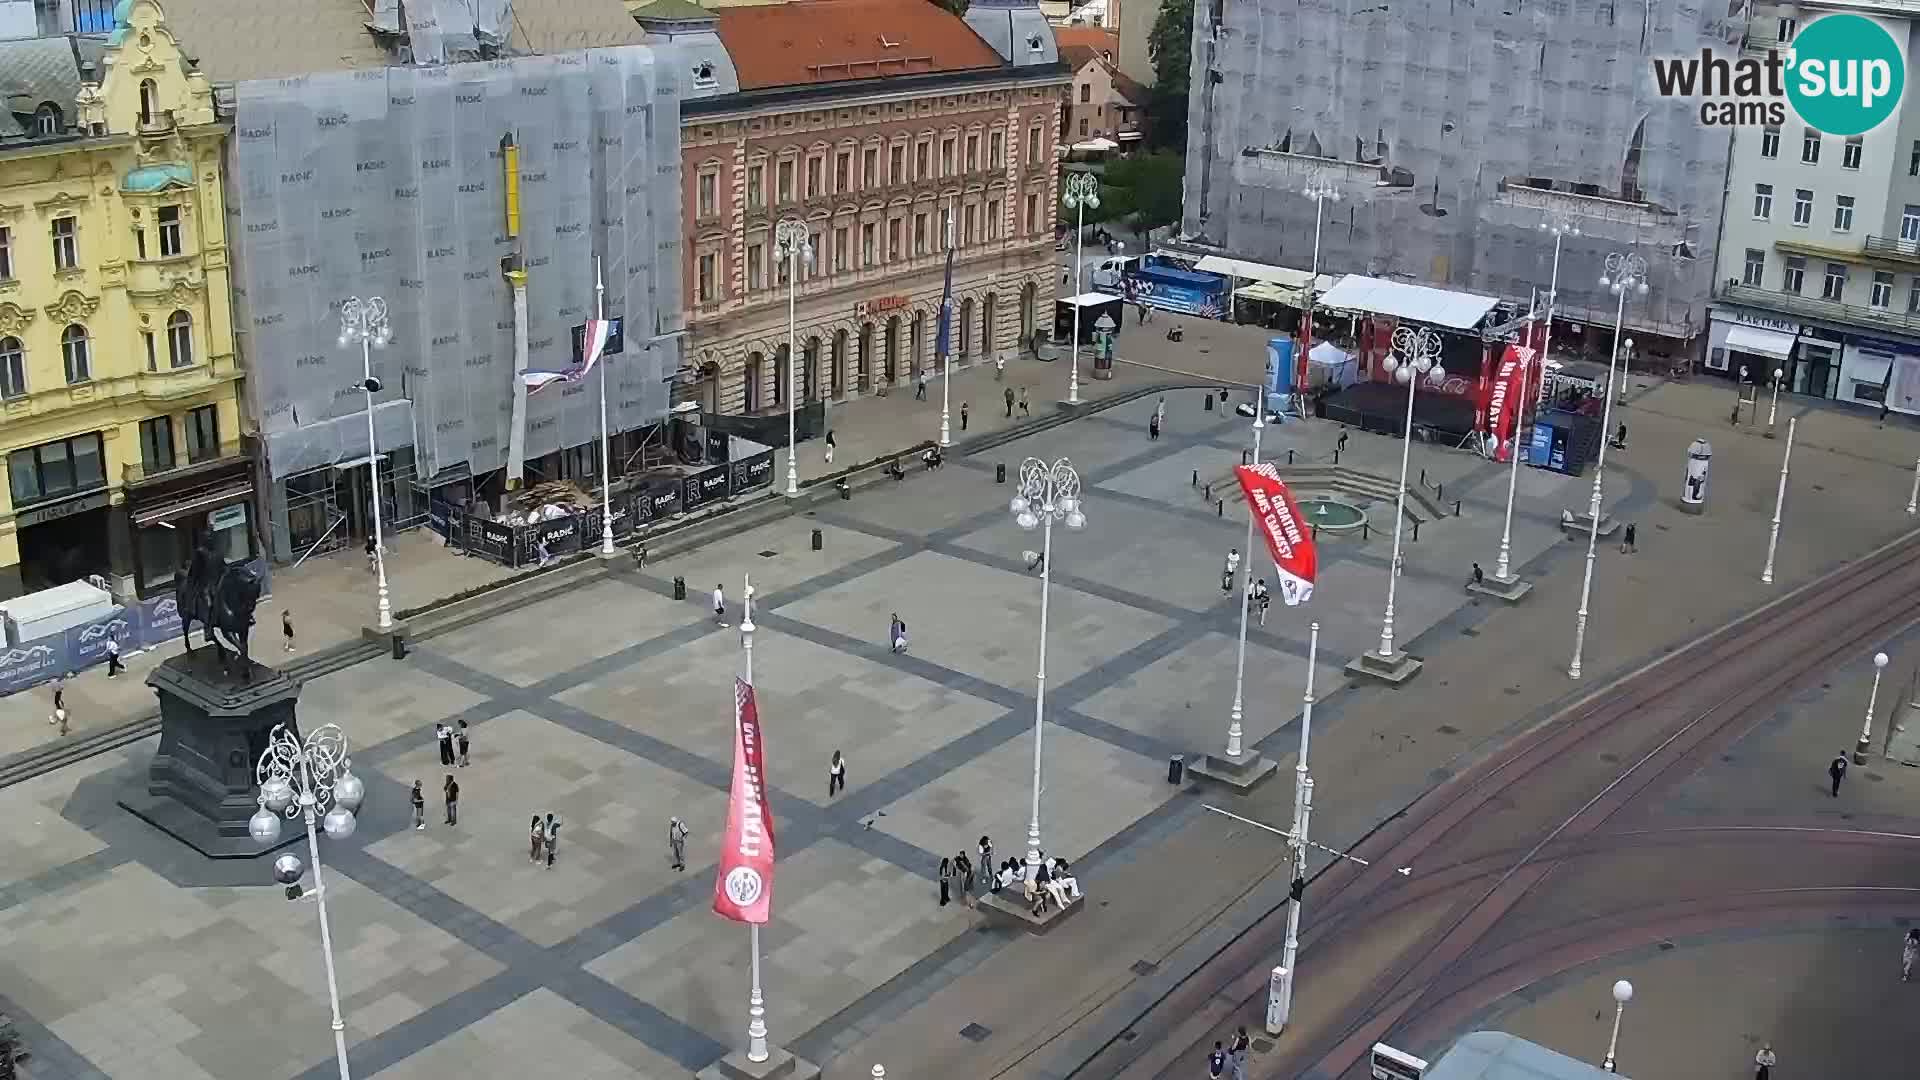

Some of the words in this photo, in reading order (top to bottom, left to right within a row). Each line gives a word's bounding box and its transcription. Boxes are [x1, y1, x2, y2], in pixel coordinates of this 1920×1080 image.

[1490, 381, 1507, 428] HRVATI
[1265, 514, 1293, 559] EMBASSY
[1271, 494, 1302, 544] CROATIAN
